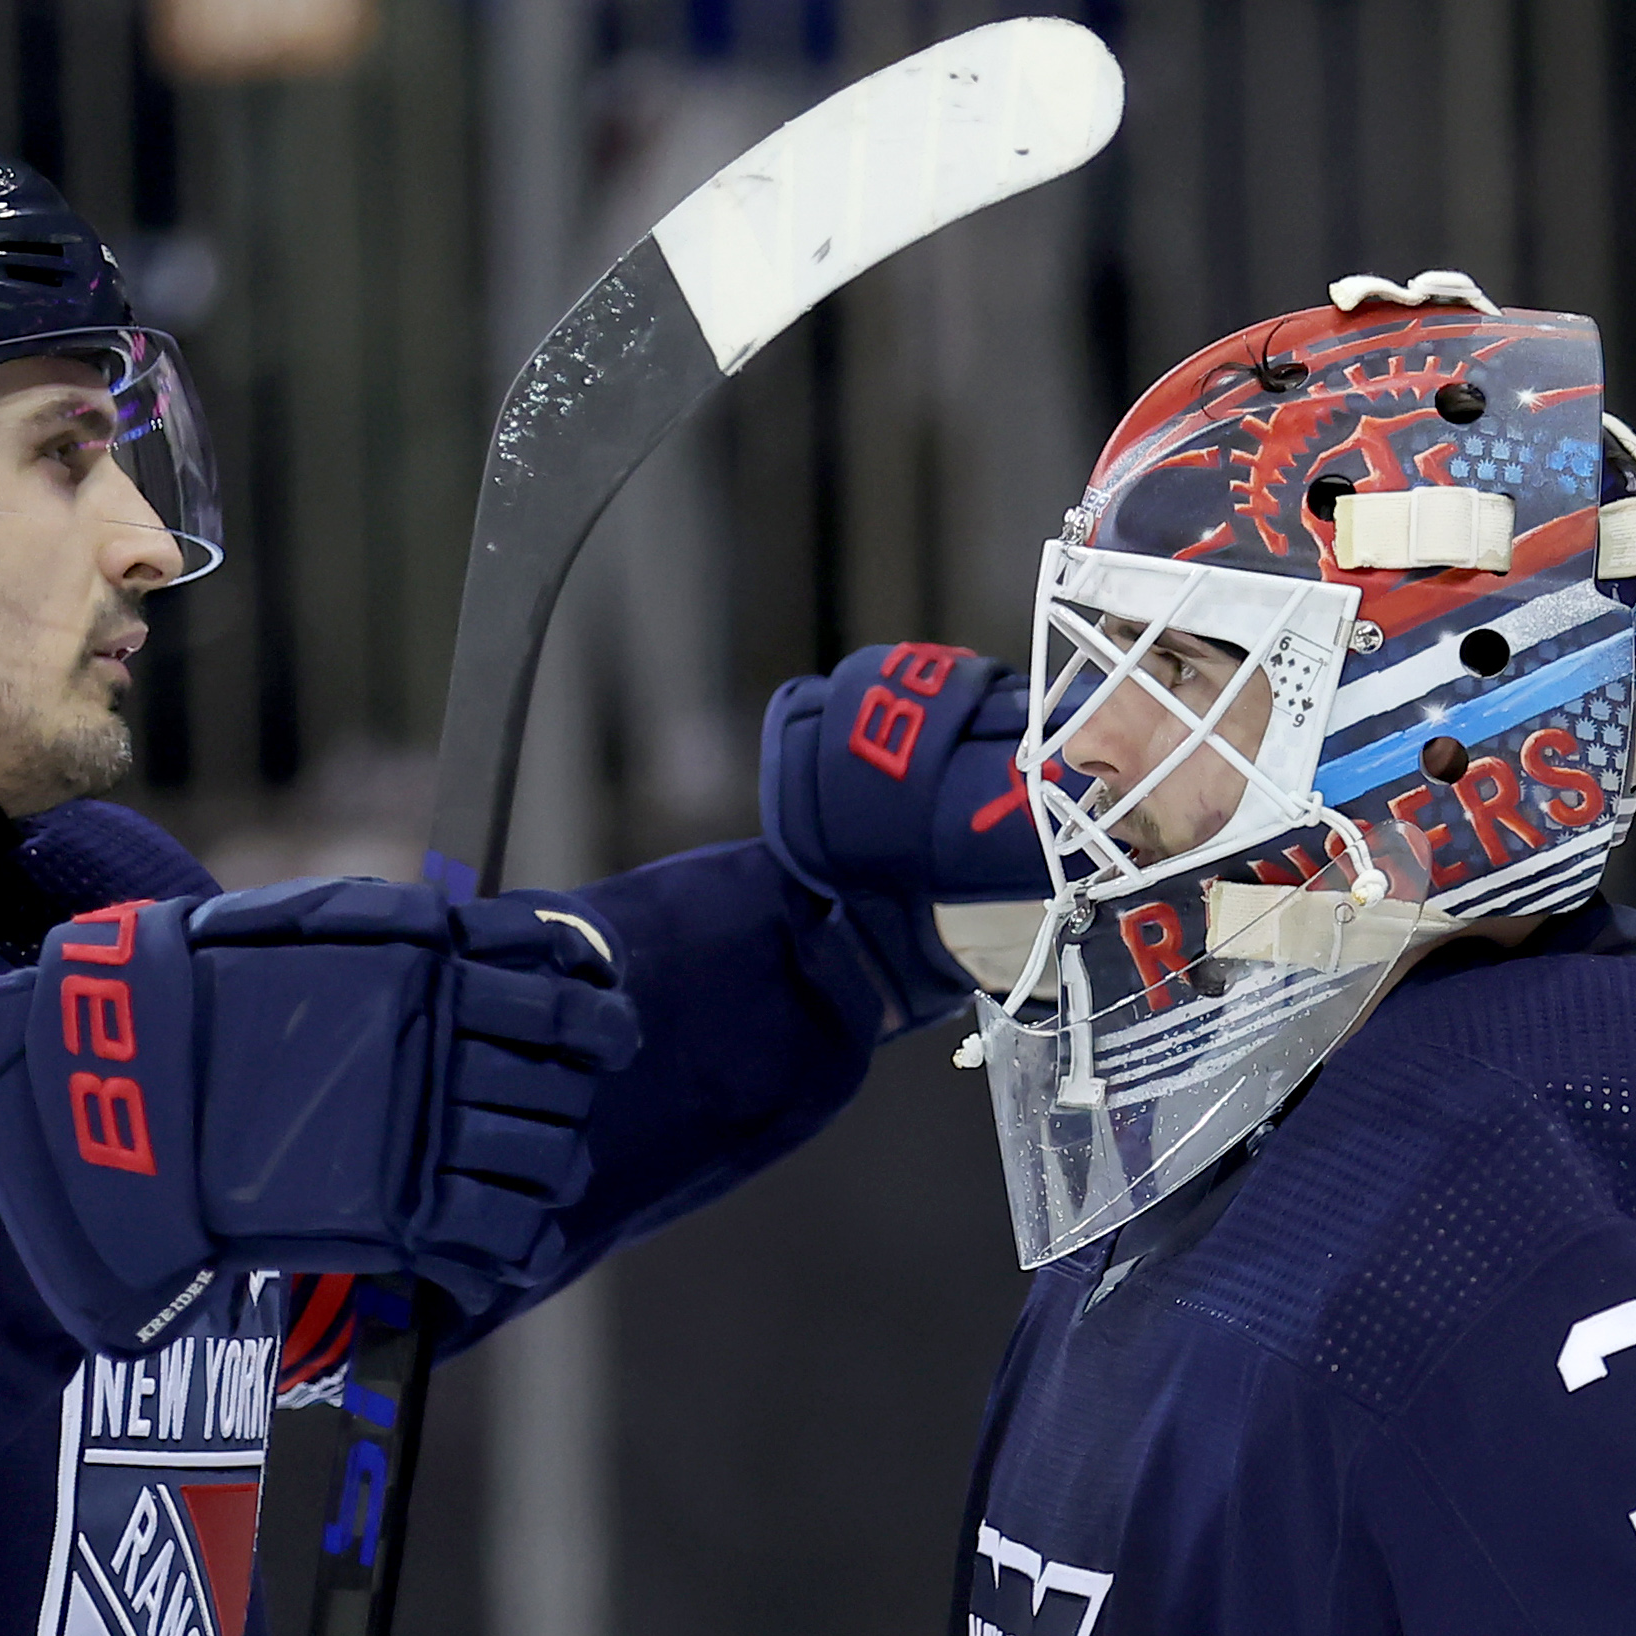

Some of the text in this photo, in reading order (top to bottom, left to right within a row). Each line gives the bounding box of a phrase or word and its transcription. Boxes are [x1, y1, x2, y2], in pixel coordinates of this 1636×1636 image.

[135, 1270, 215, 1343] KREIDER
[91, 1336, 274, 1440] NEW YORK
